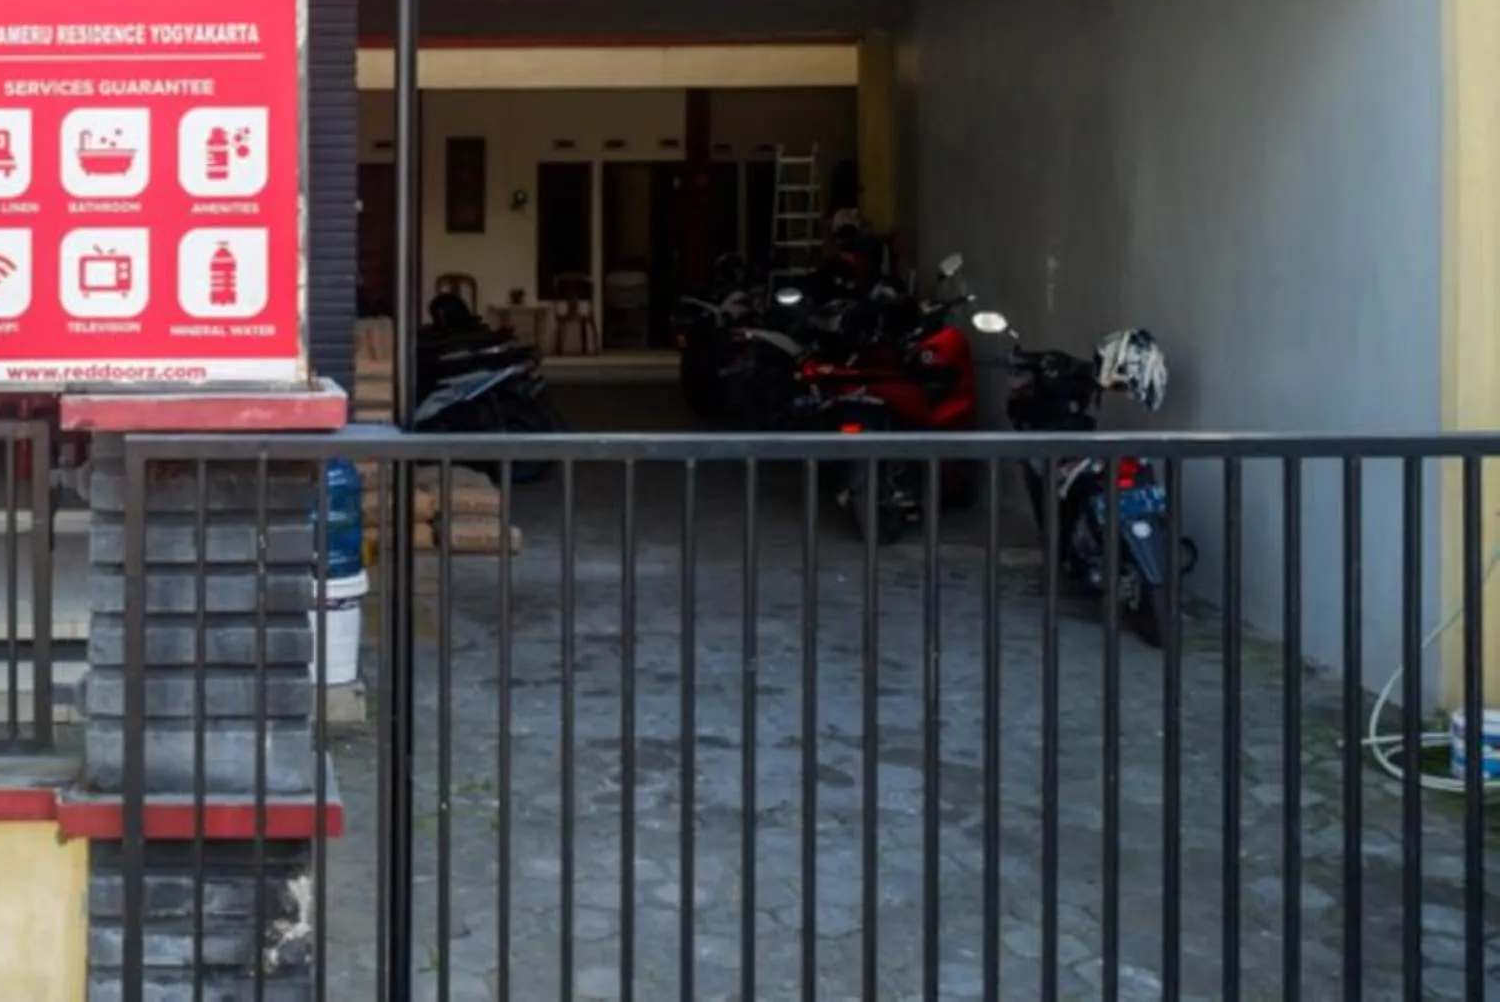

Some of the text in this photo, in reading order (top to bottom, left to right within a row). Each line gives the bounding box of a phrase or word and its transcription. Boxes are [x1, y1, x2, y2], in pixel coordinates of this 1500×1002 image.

[57, 23, 146, 45] RESIDENCE
[150, 22, 260, 45] YOGYAKARTA
[4, 78, 215, 97] SERVICES GUARANTEE
[6, 362, 207, 381] www.reddoorz.com
